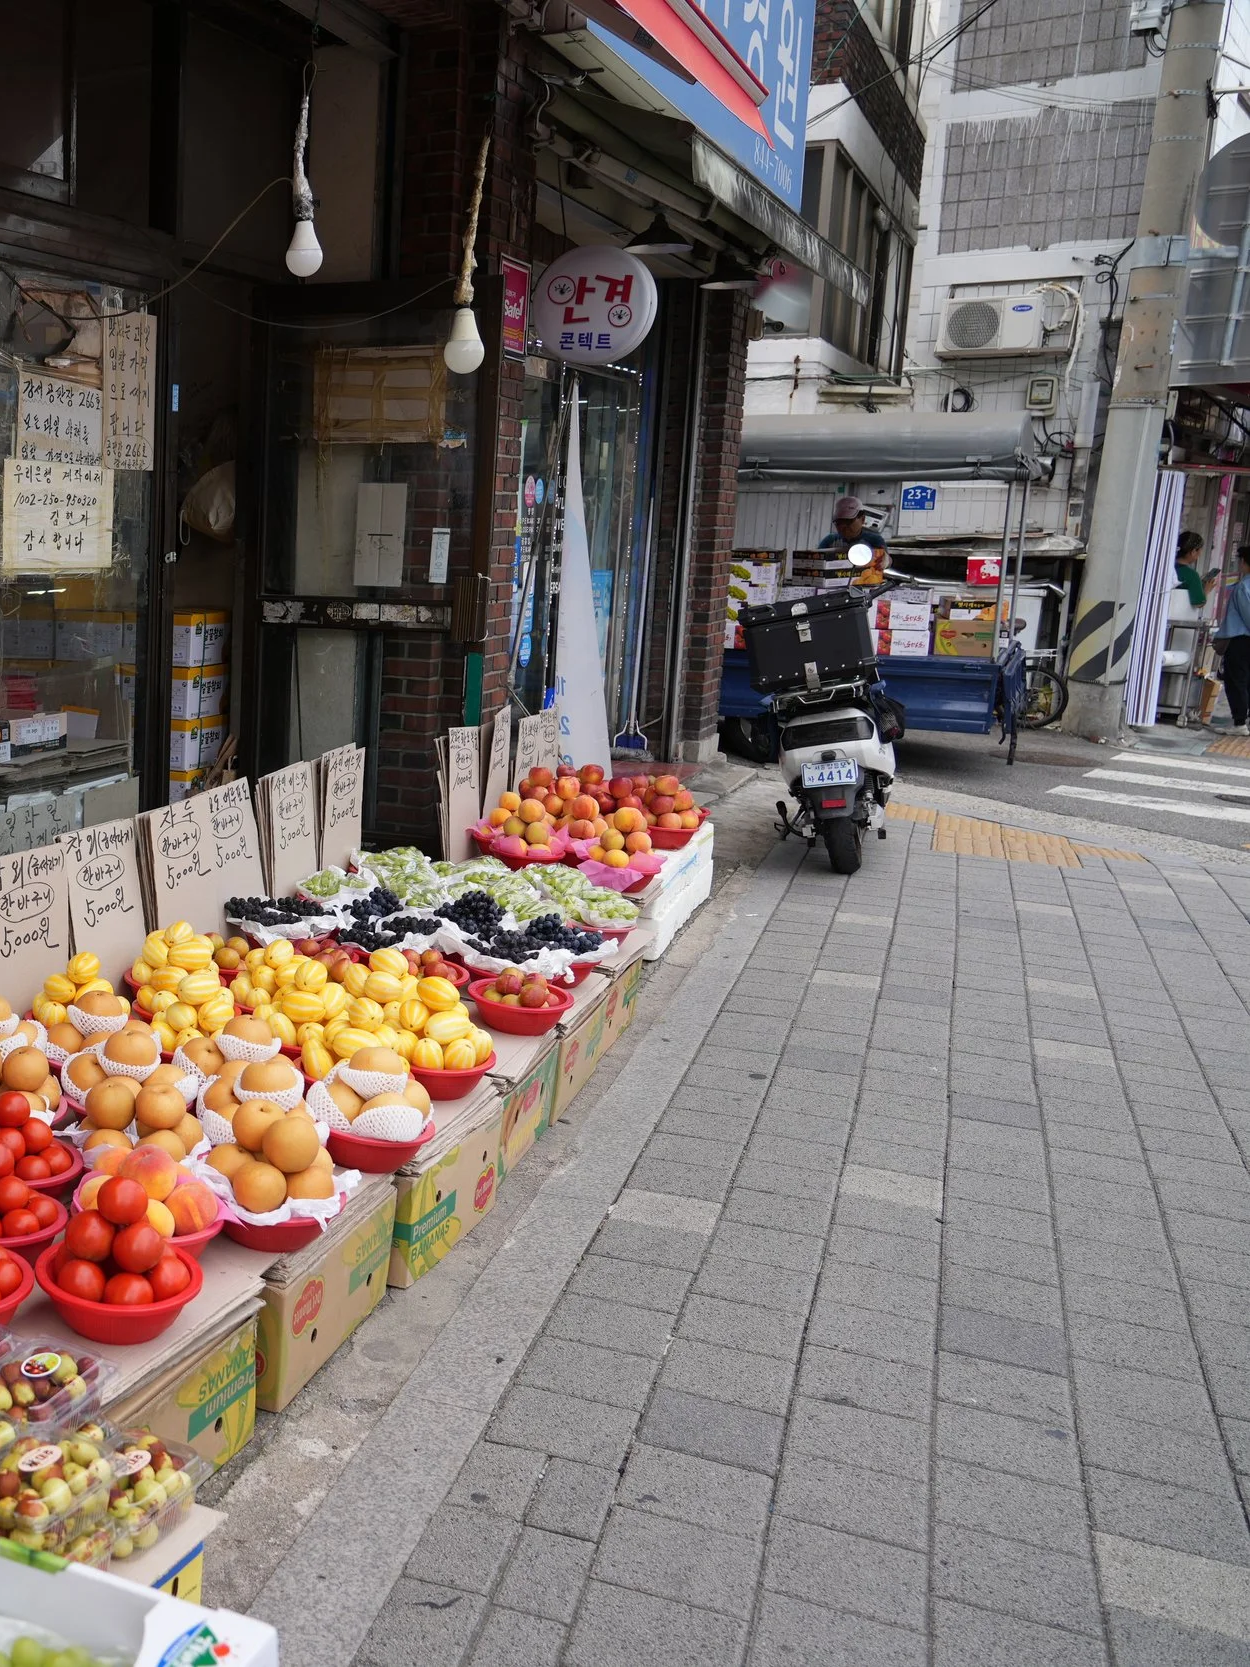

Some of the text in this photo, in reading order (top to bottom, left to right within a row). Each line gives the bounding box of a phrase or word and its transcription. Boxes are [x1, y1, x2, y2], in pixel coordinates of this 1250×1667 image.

[754, 137, 791, 194] 844-7006
[547, 275, 634, 328] 안경
[559, 332, 612, 351] 콘텍트
[14, 464, 52, 483] 우리은행
[907, 489, 931, 499] 23-1
[22, 530, 84, 554] 감사합니다
[818, 769, 853, 782] 4414
[160, 800, 194, 828] 자두
[216, 834, 253, 868] 5.000원
[82, 860, 123, 886] 한바구니
[166, 851, 212, 890] 5.000원
[0, 888, 50, 918] 한바구니
[84, 886, 134, 928] 5.000원
[0, 916, 60, 959] 5.000원
[412, 1205, 448, 1242] Premium
[411, 1218, 451, 1262] BANANAS
